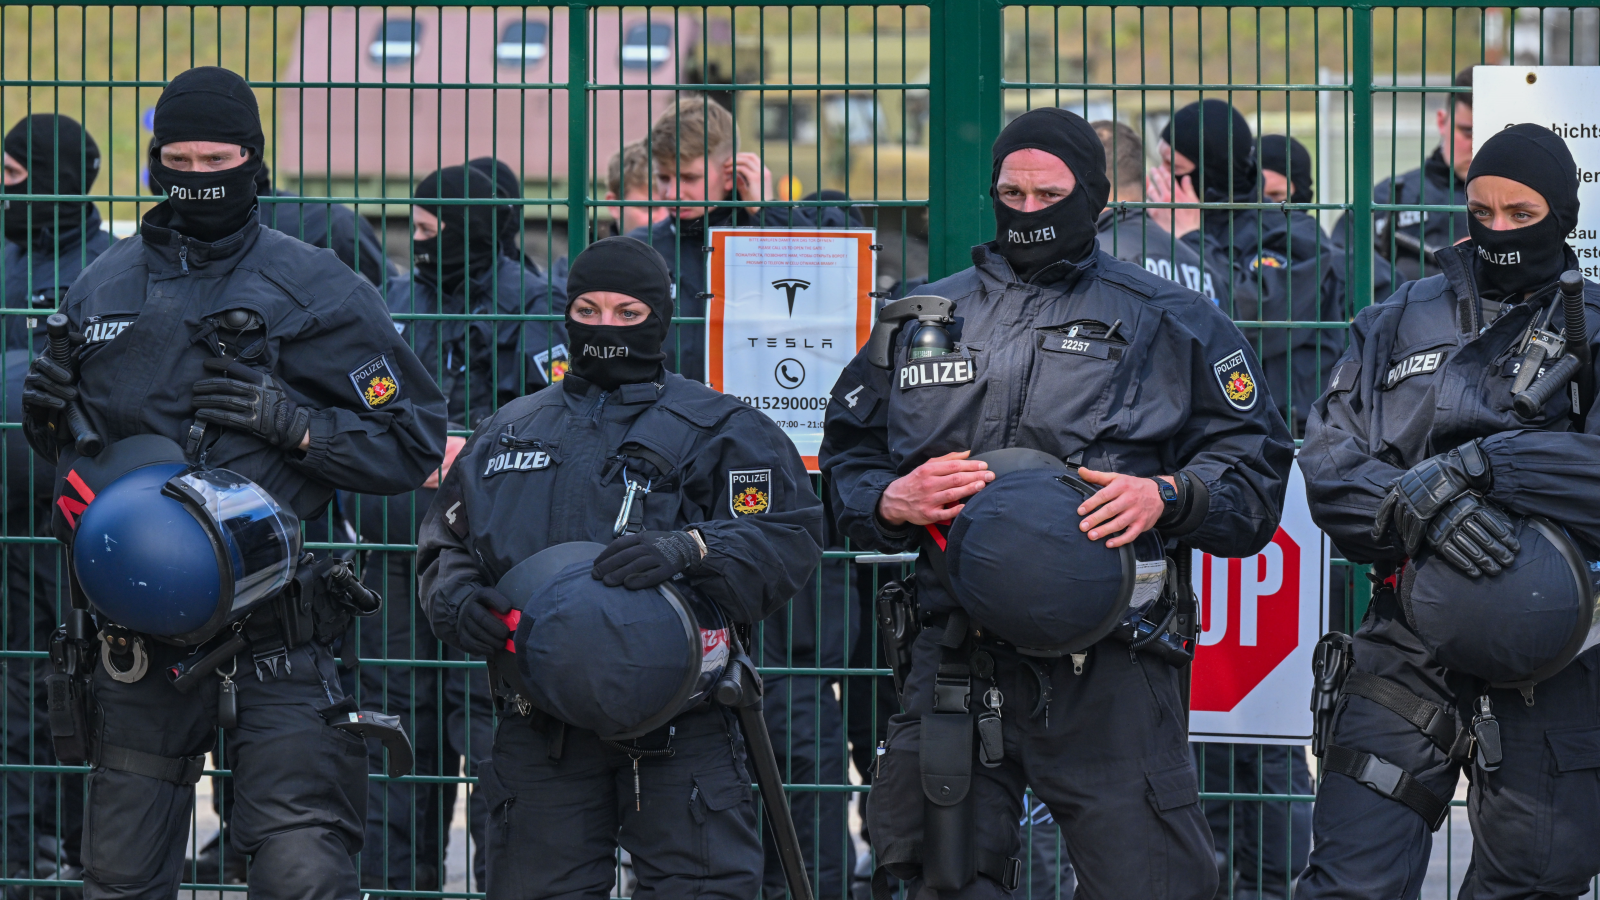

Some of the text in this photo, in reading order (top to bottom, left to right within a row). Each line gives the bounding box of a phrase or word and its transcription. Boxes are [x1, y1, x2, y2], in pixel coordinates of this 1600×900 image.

[170, 185, 225, 200] POLIZEI
[1008, 226, 1056, 244] POLIZEI
[1567, 227, 1597, 239] Bau
[1477, 245, 1521, 265] POLIZEI
[1570, 245, 1600, 258] rst
[83, 321, 135, 344] OLIZE
[583, 343, 629, 359] POLIZEI
[747, 337, 832, 348] TESLA
[1071, 339, 1100, 352] 22257
[355, 359, 385, 383] POLIZEI
[900, 360, 973, 388] POLIZEI
[1216, 355, 1243, 375] POLIZEI
[1387, 352, 1442, 384] POLIZEI
[737, 396, 832, 410] 915290009
[844, 384, 865, 409] 4
[483, 451, 551, 475] POLIZEI
[733, 473, 768, 484] POLIZEI
[445, 500, 461, 525] 4
